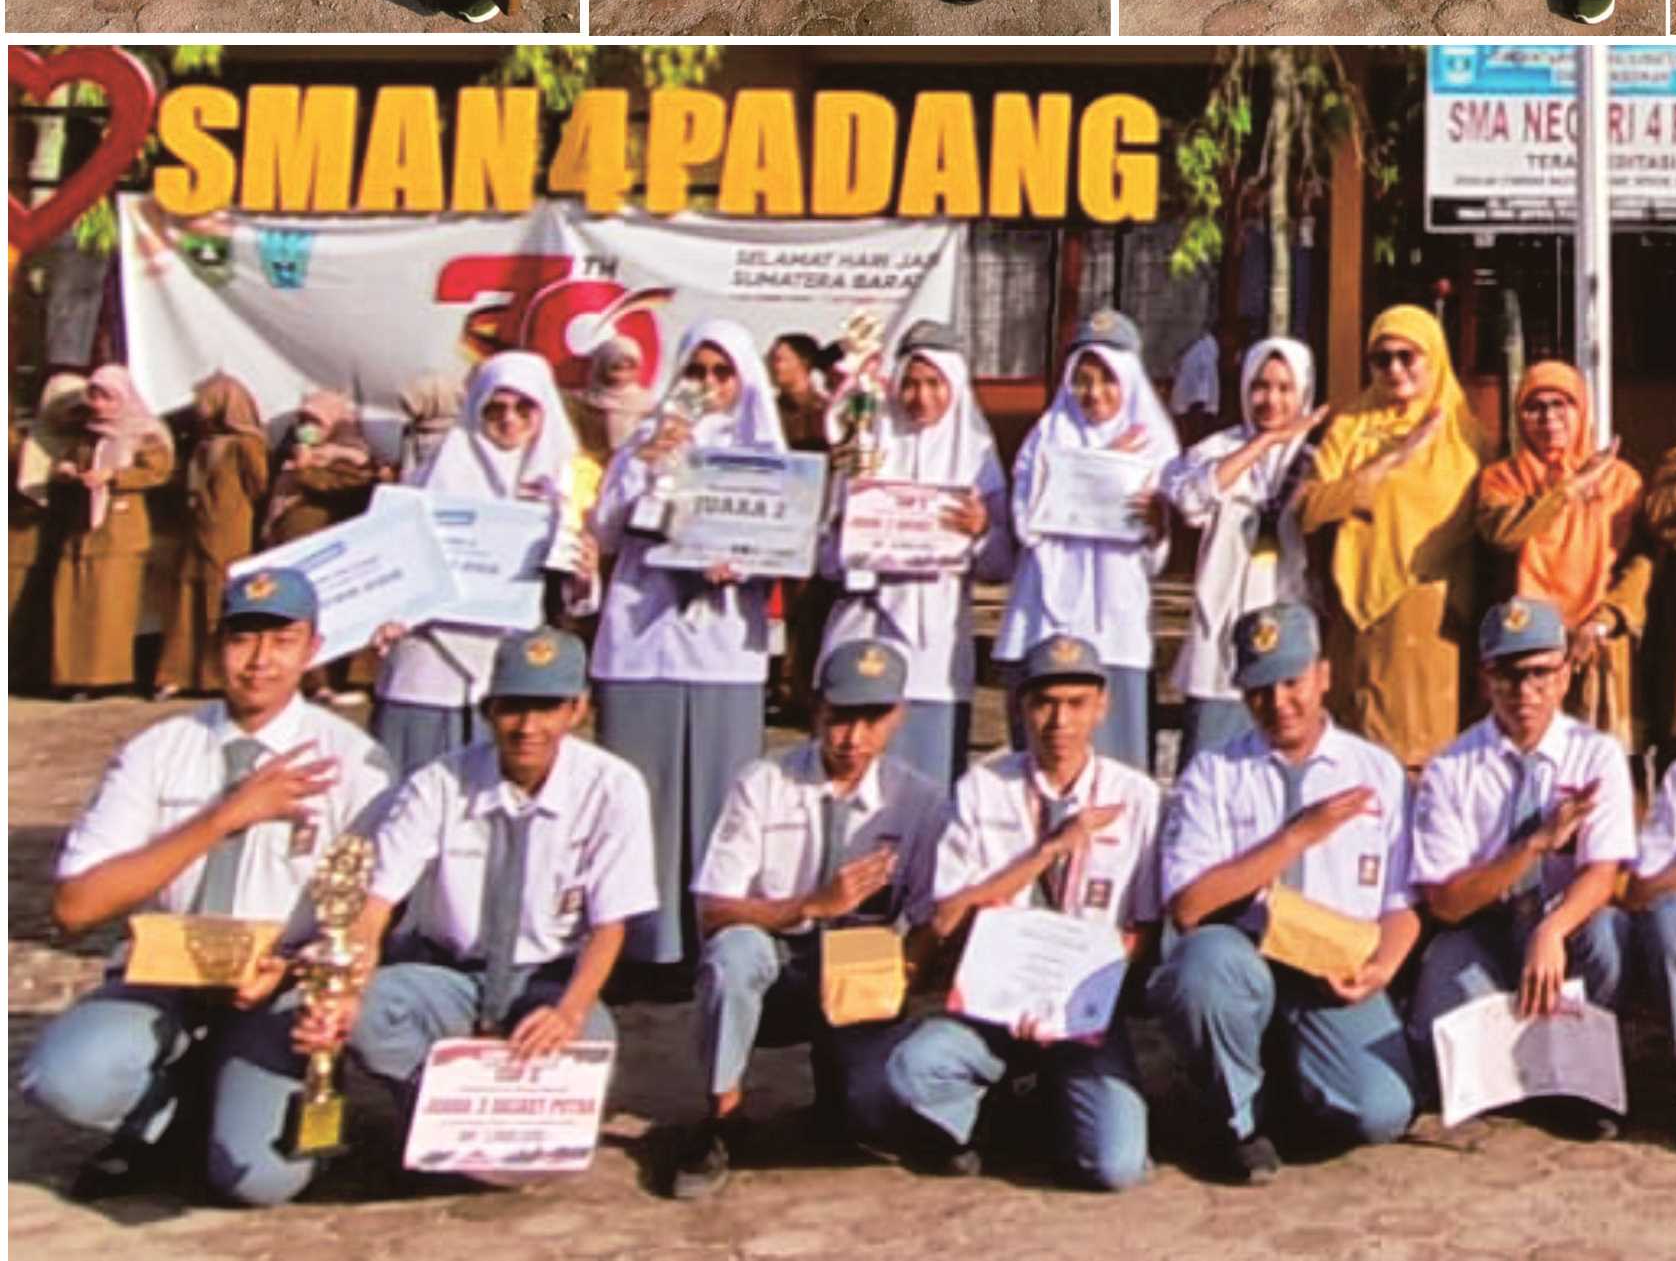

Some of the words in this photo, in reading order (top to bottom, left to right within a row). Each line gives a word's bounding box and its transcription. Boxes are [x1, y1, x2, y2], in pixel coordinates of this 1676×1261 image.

[1447, 100, 1510, 144] SMA
[1645, 102, 1662, 142] 4
[734, 248, 836, 270] SELAMAT
[838, 250, 893, 270] HARI
[731, 269, 848, 290] SUMATERA
